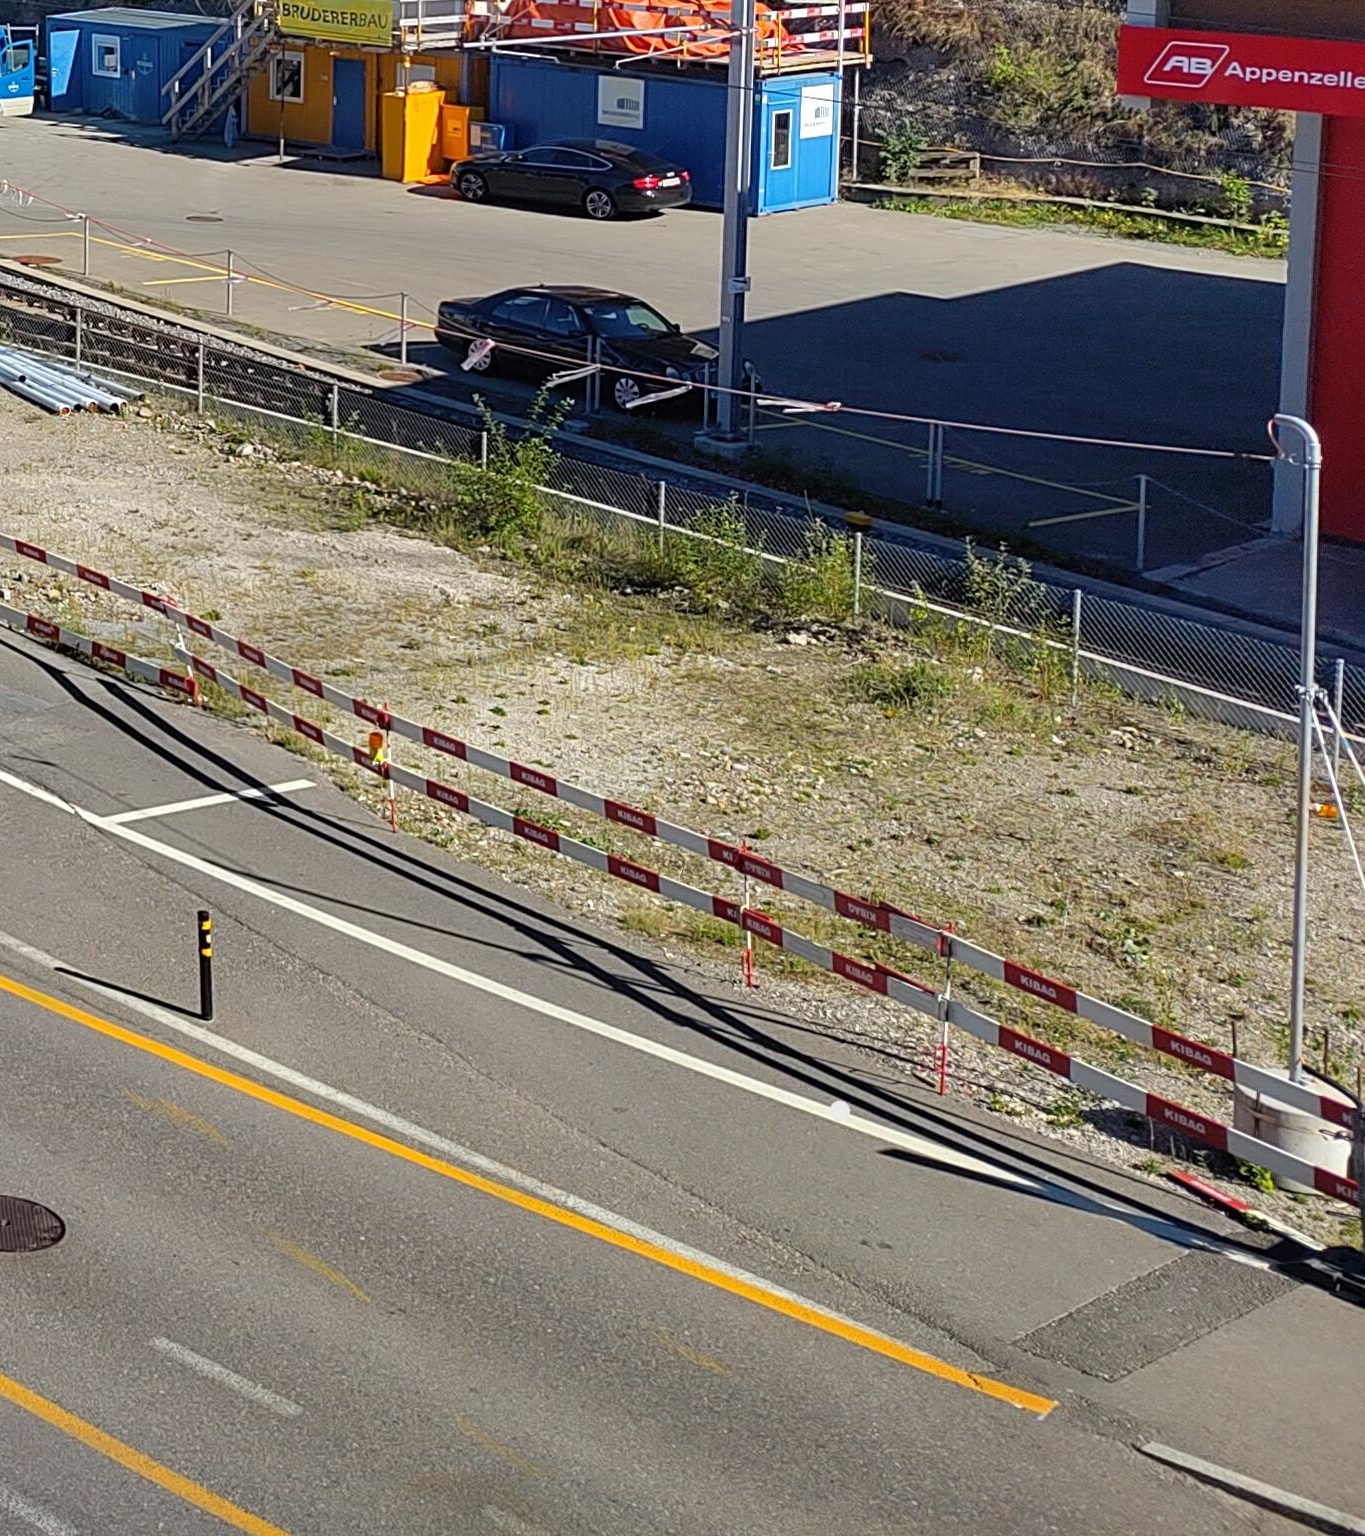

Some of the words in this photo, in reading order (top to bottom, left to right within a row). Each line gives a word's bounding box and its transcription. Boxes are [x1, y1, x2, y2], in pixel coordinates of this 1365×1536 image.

[282, 2, 389, 29] BRUDERERBAU
[1162, 55, 1214, 75] AB
[1020, 975, 1057, 999] KIBAG
[1014, 1039, 1052, 1064] KIBAG
[1170, 1040, 1213, 1066] KIBAG
[1163, 1108, 1206, 1135] KIBAG
